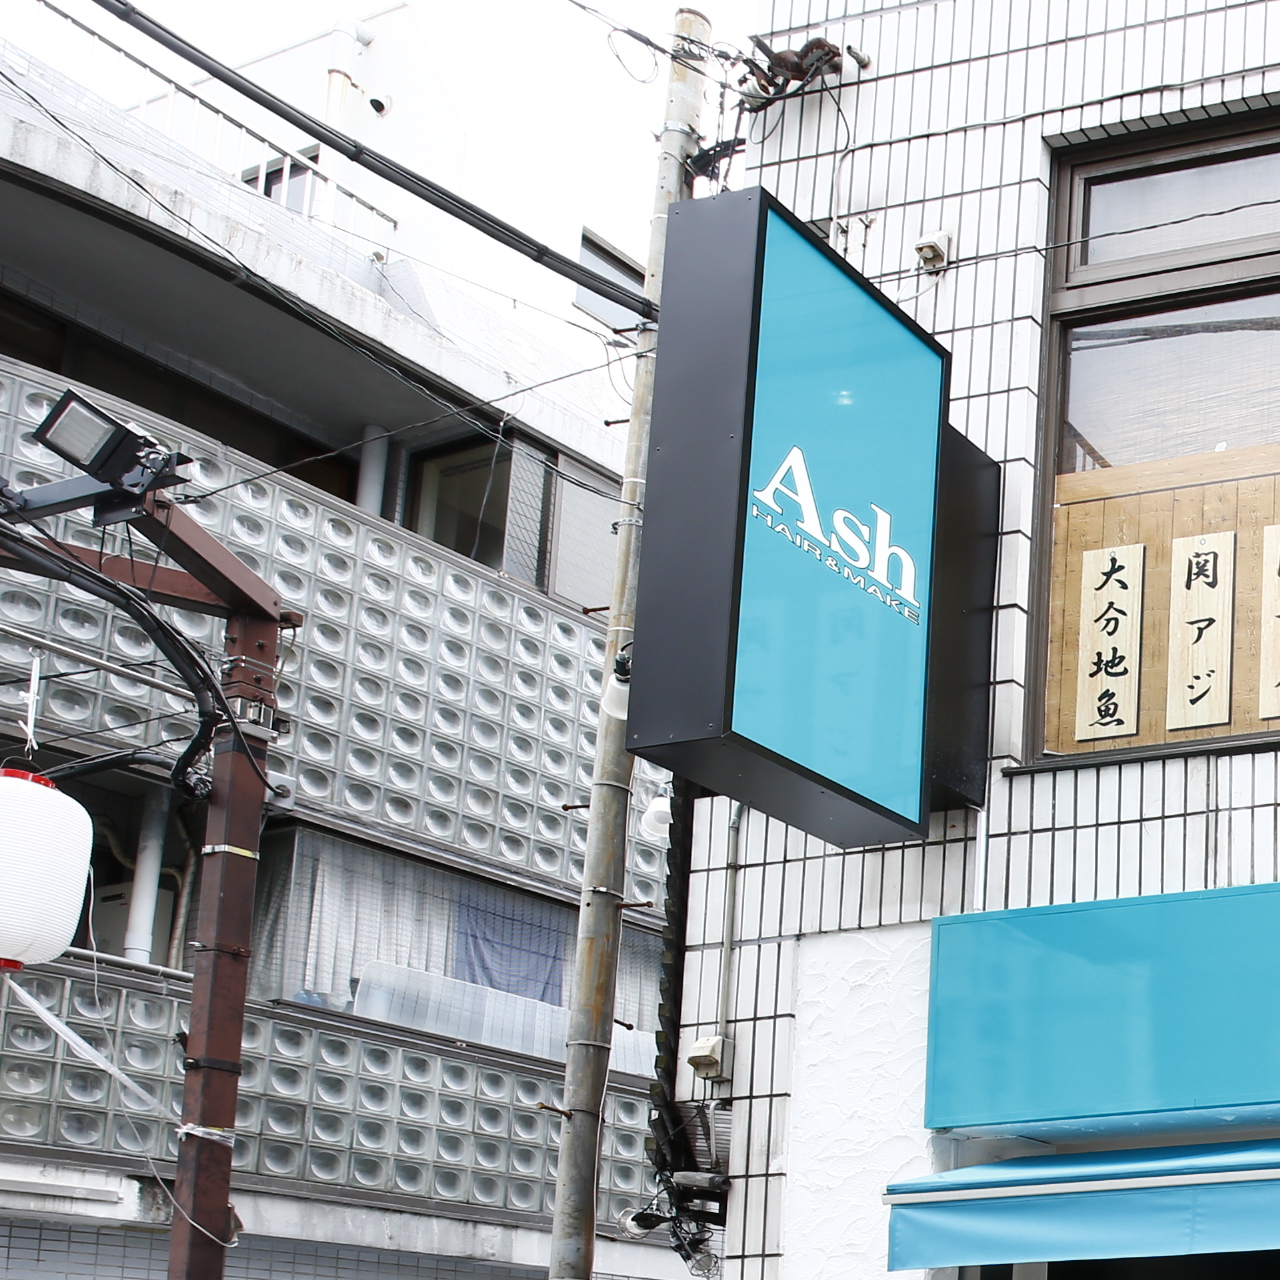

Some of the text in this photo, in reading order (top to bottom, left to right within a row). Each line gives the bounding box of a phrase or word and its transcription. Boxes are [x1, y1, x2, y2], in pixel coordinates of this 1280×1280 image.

[752, 503, 921, 626] HAIR&MAKE
[753, 444, 921, 609] Ash
[1088, 555, 1130, 729] 大分地魚
[1185, 549, 1220, 707] 関アジ
